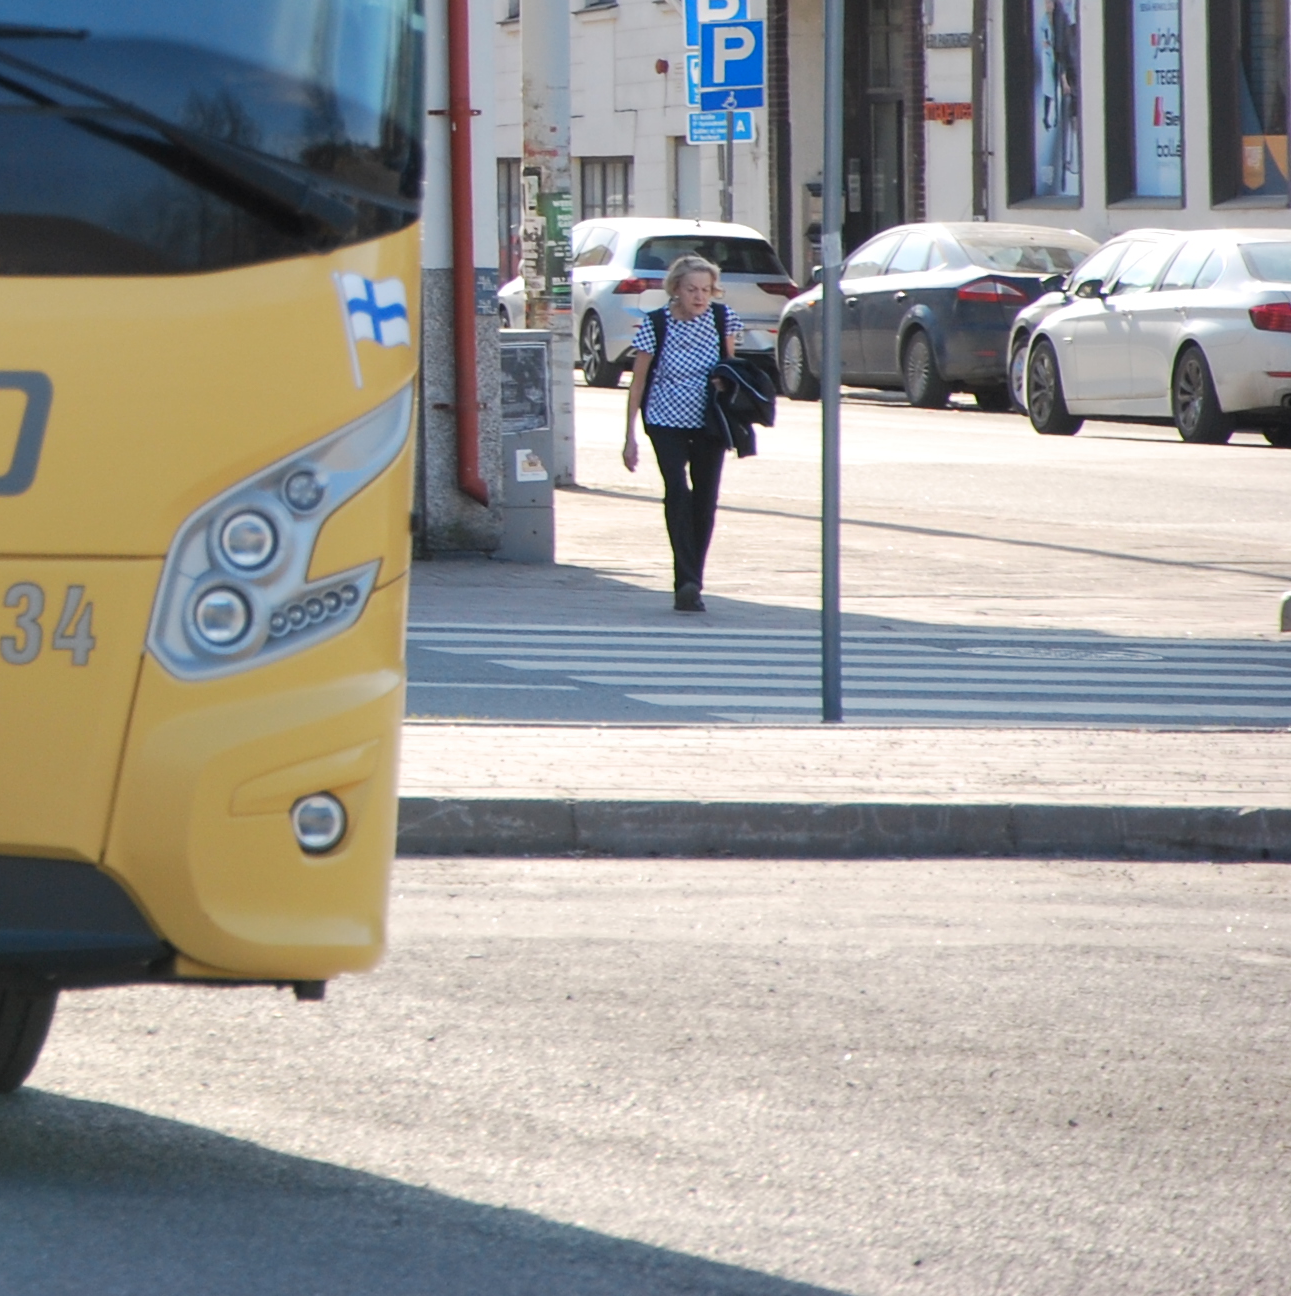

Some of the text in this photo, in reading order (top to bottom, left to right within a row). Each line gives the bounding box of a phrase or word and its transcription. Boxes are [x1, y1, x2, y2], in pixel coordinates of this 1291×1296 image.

[713, 25, 756, 84] P
[735, 119, 746, 132] A
[0, 581, 97, 667] 34
